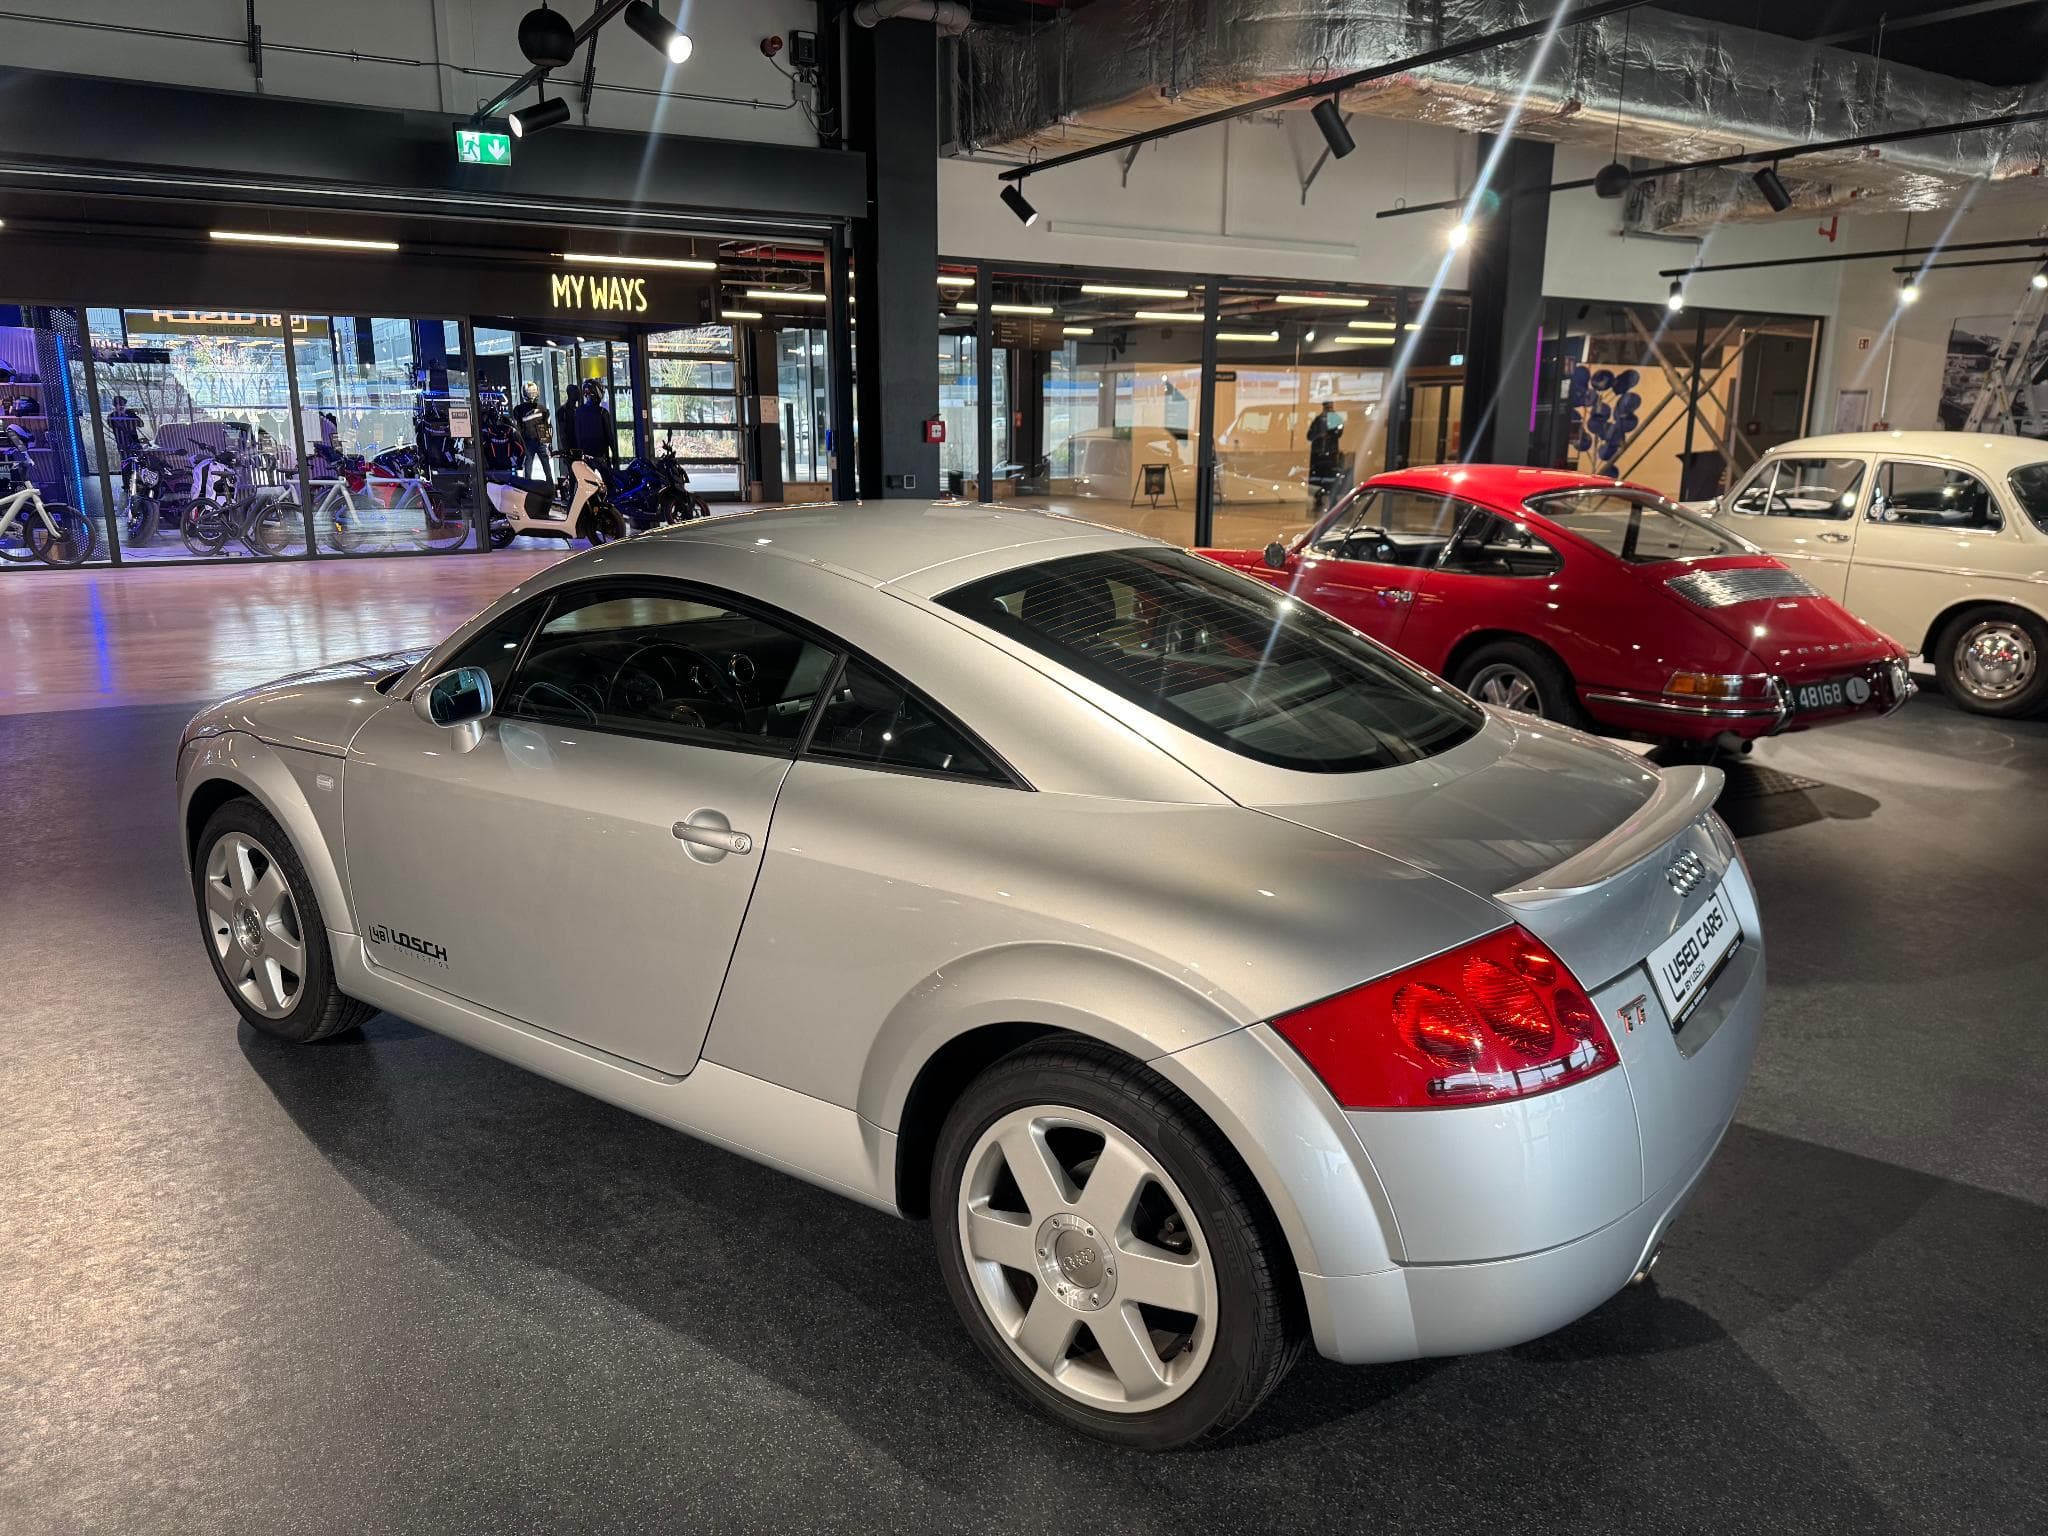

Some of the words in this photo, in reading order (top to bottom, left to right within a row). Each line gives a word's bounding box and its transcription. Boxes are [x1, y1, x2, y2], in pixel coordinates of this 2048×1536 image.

[552, 273, 584, 309] MY
[589, 276, 647, 312] WAYS
[1800, 683, 1842, 708] 48168
[391, 929, 448, 961] LOSCH
[1668, 937, 1700, 984] USED
[1696, 907, 1724, 949] CARS
[1691, 963, 1706, 986] LOSCH
[1617, 994, 1647, 1034] TT
